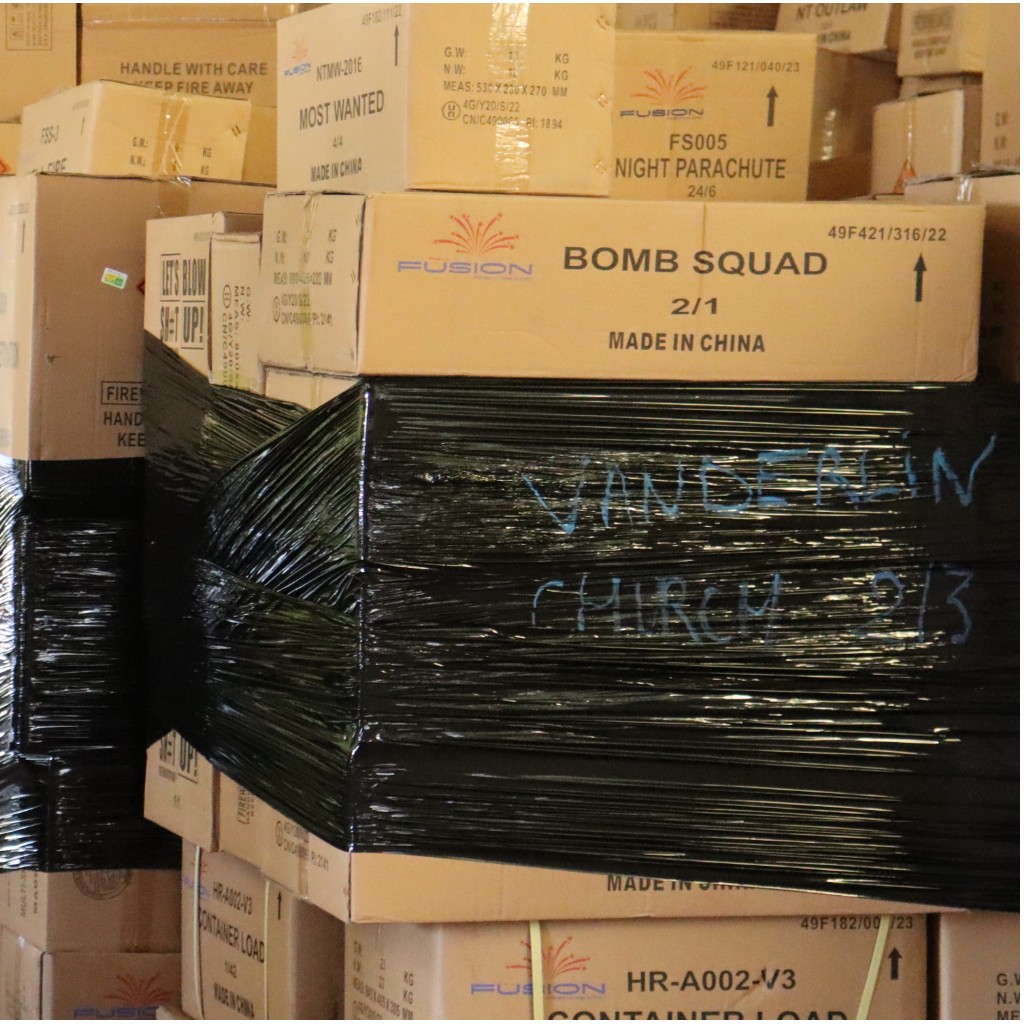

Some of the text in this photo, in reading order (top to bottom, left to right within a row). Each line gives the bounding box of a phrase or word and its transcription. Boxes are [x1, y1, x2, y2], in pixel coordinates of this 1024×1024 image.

[555, 53, 569, 64] KG
[711, 60, 800, 73] 49F121/040/23
[120, 62, 268, 76] HANDLE WITH CARE
[316, 56, 363, 82] NTMW-2016
[554, 69, 569, 80] KG
[177, 82, 209, 93] FIRE
[213, 82, 254, 94] AWAY
[522, 85, 527, 95] X
[530, 86, 547, 96] 270
[552, 86, 568, 97] MM
[299, 89, 385, 131] MOST WANTED
[463, 100, 520, 112] 4G/Y20/S/22
[619, 107, 705, 118] FUSION
[541, 118, 563, 129] 1894
[332, 135, 344, 149] 4/4
[669, 133, 727, 151] FS005
[202, 147, 212, 158] KG
[200, 165, 210, 176] KG
[310, 156, 363, 182] MADE IN CHINA
[615, 158, 787, 179] NIGHT PARACHUTE
[687, 184, 717, 198] 24/6
[328, 229, 338, 242] KG
[827, 226, 947, 242] 49F421/316/22
[326, 250, 335, 264] KG
[563, 246, 828, 276] BOMB SQUAD
[397, 260, 533, 276] FUSION
[182, 258, 207, 296] BLOW
[670, 298, 718, 315] 2/1
[183, 306, 204, 344] UP!
[608, 331, 766, 353] MADE IN CHINA
[521, 432, 997, 536] VANDERLIN
[531, 570, 785, 646] CHURCH
[607, 874, 664, 891] MADE
[212, 881, 253, 916] HR-A002-V3
[800, 916, 914, 930] 49F182/00/23
[198, 906, 266, 964] CONTAINER LOAD
[404, 970, 414, 986] KG
[627, 968, 797, 992] HR-A002-V3
[403, 989, 414, 1004] KG
[470, 982, 607, 995] FUSION
[212, 982, 255, 1018] MADE IN CHINA
